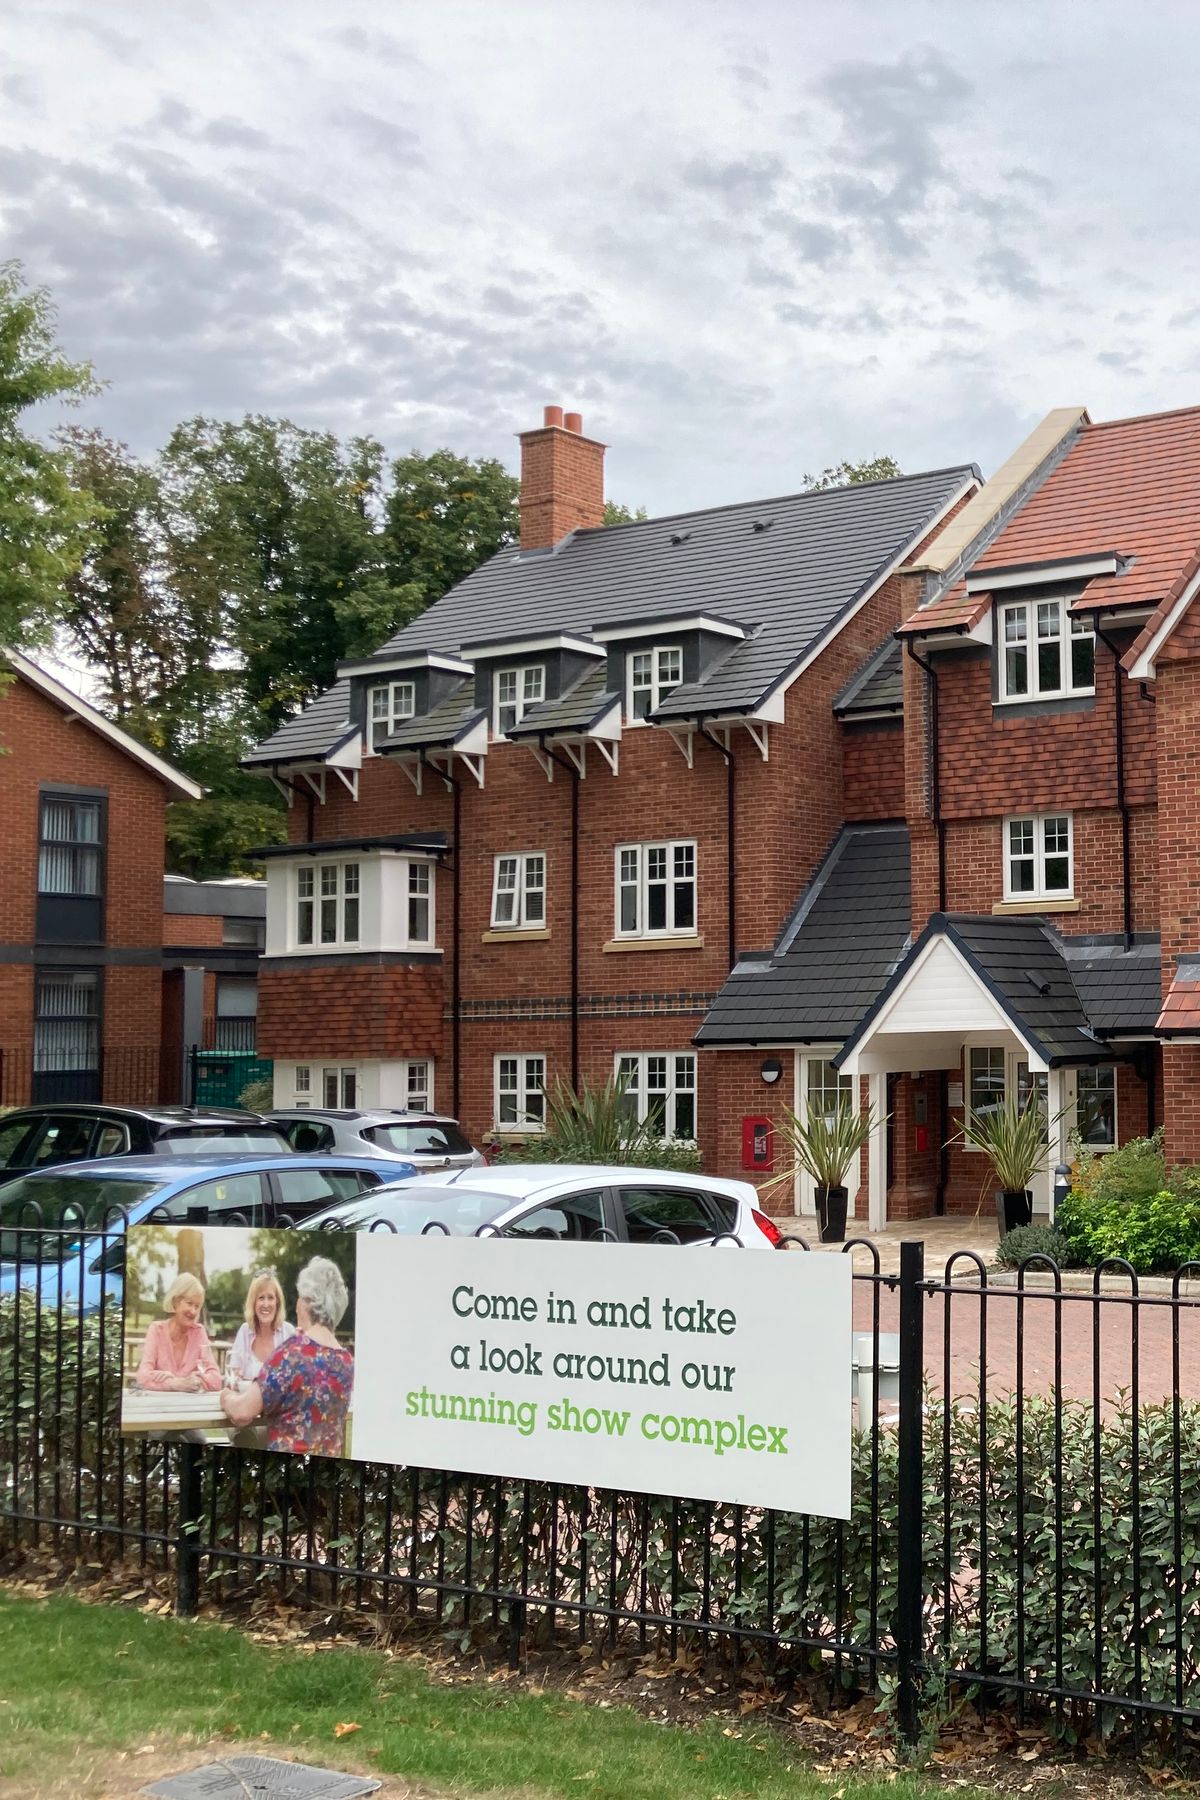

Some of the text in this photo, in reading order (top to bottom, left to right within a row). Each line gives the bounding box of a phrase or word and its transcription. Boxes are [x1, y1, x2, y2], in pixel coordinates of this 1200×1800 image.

[452, 1285, 737, 1336] Come in and take
[450, 1339, 736, 1393] a look around our
[406, 1386, 788, 1457] stunning show complex
